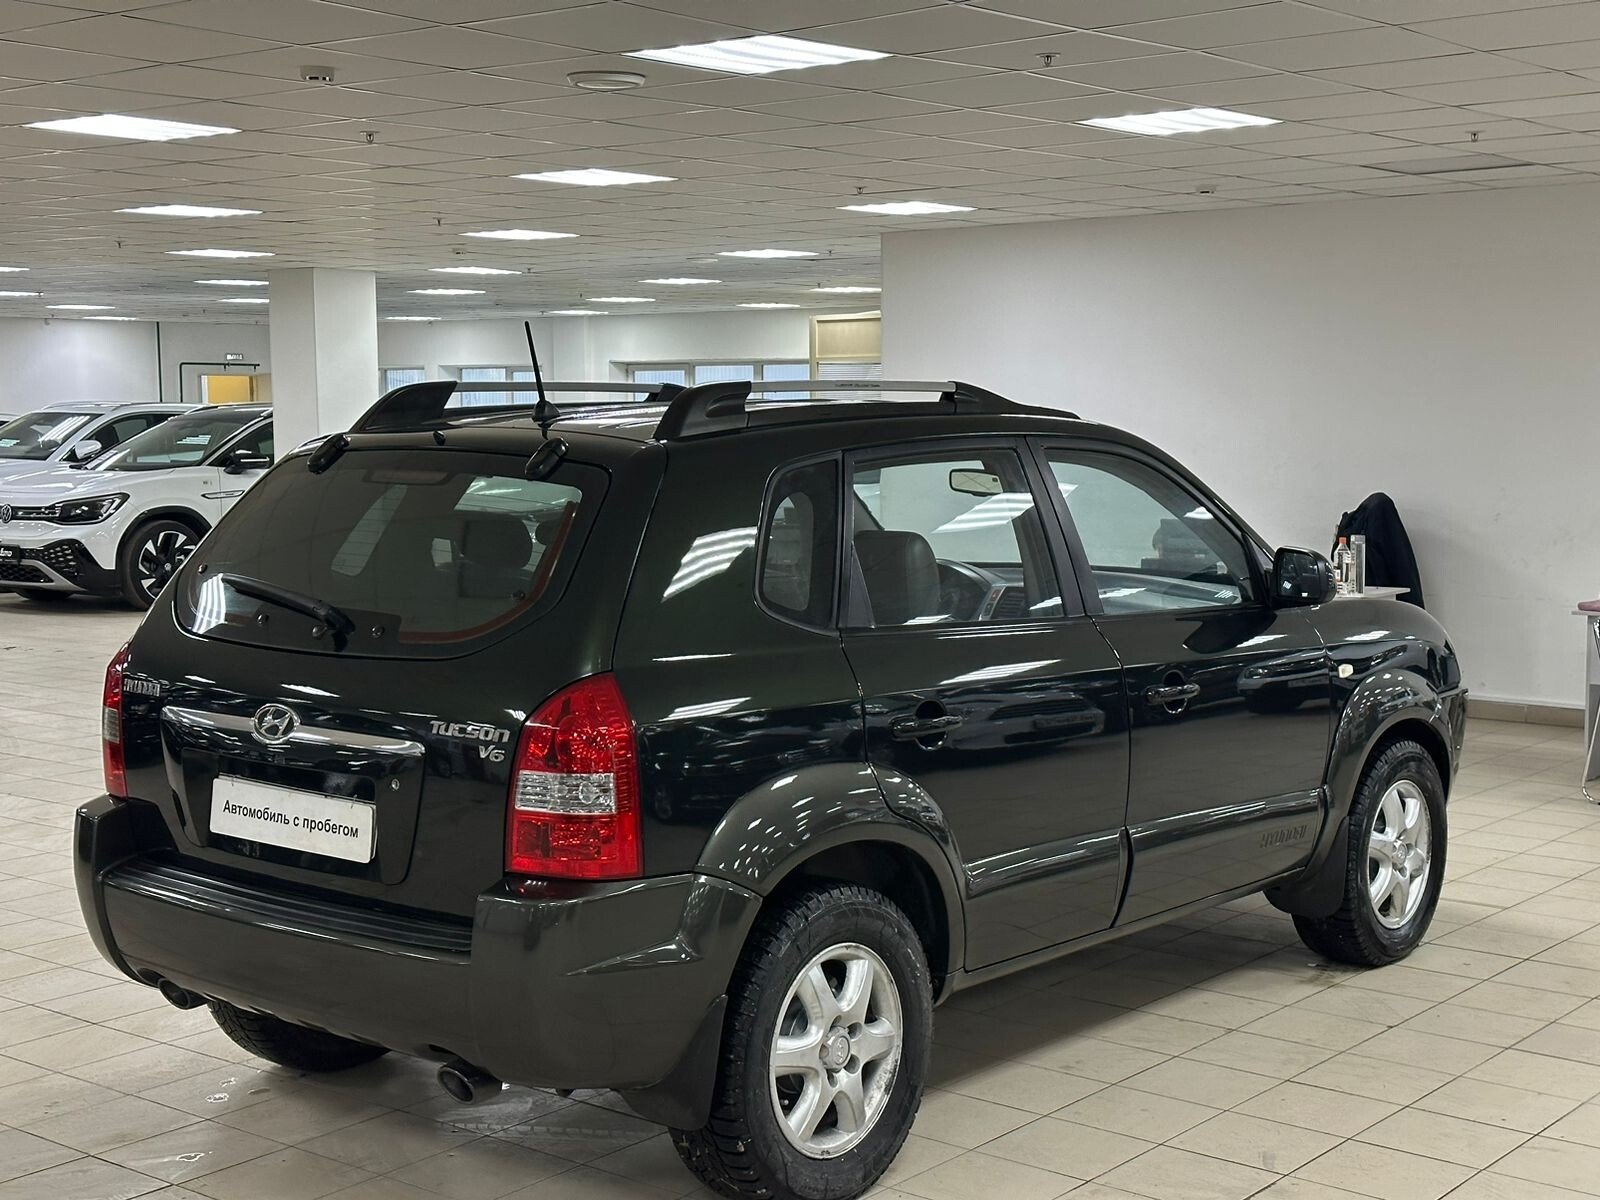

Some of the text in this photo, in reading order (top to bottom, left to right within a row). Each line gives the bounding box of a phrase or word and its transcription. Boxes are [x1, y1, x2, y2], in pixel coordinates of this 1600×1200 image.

[479, 745, 505, 762] V6
[223, 799, 359, 838] Автомобиль с пробегом
